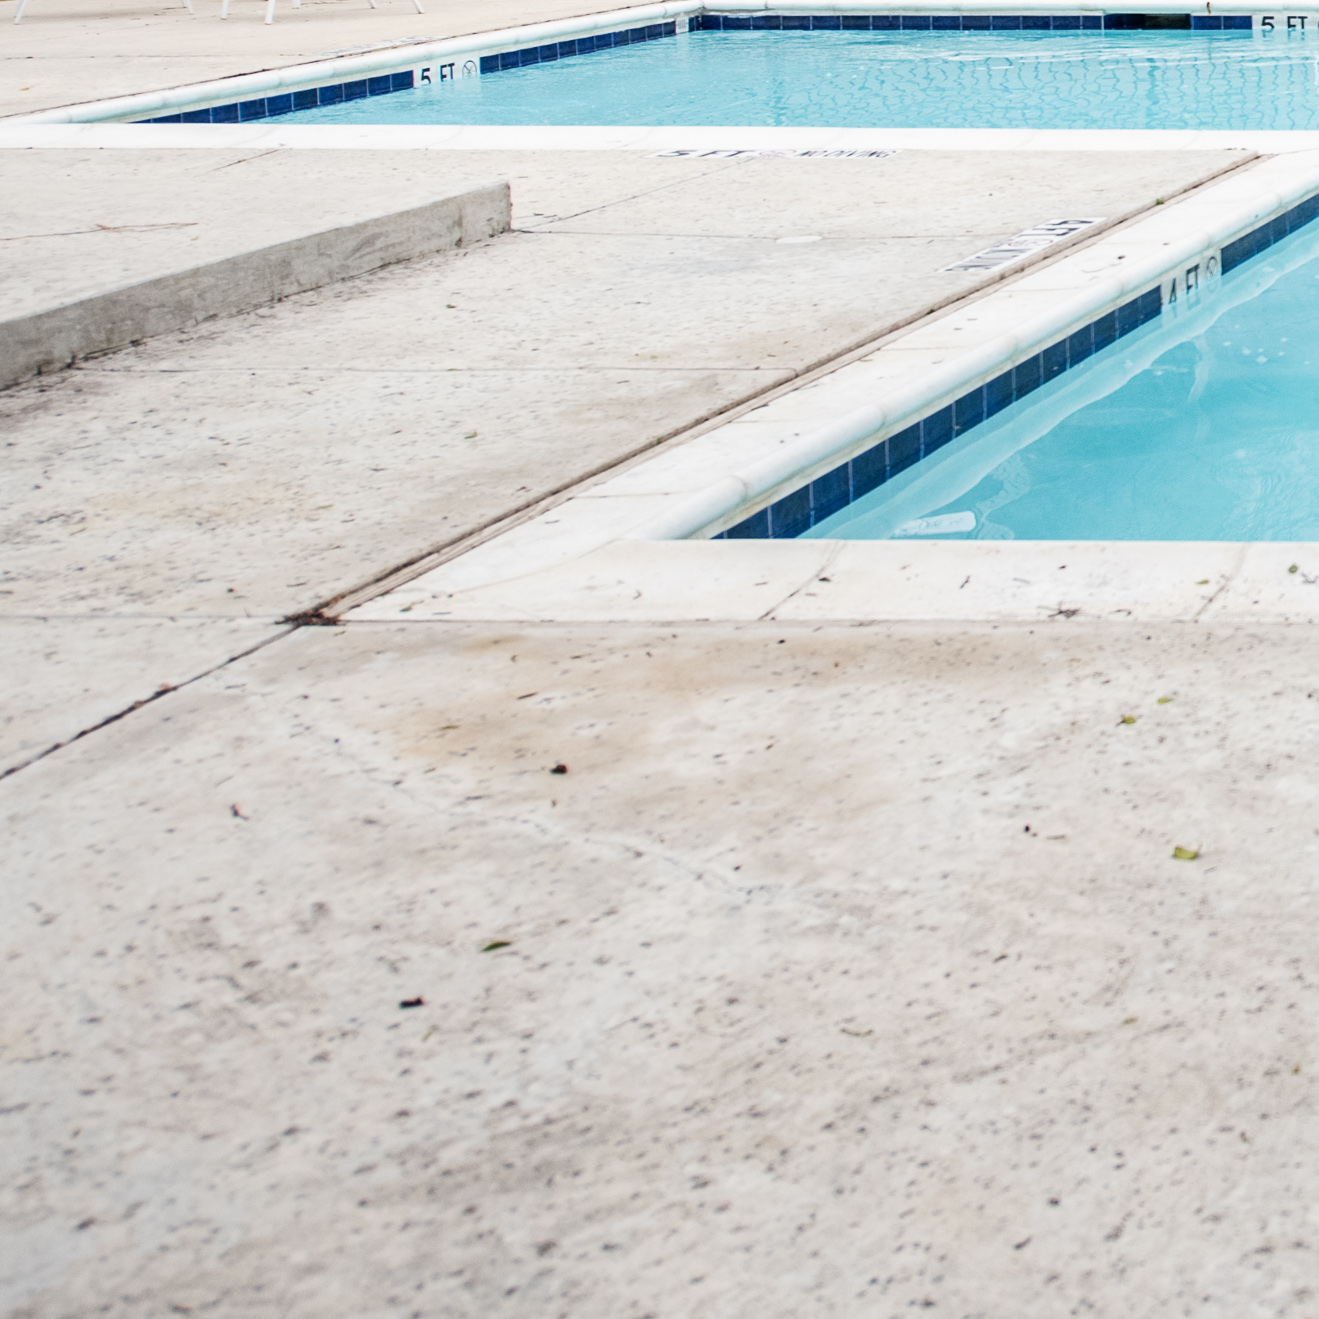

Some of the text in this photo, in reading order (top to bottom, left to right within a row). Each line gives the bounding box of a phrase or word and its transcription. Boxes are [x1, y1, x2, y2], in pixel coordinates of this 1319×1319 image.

[1261, 15, 1308, 30] 5 FT
[421, 62, 455, 84] 5 FT
[698, 149, 756, 158] FT
[1185, 263, 1200, 295] FT
